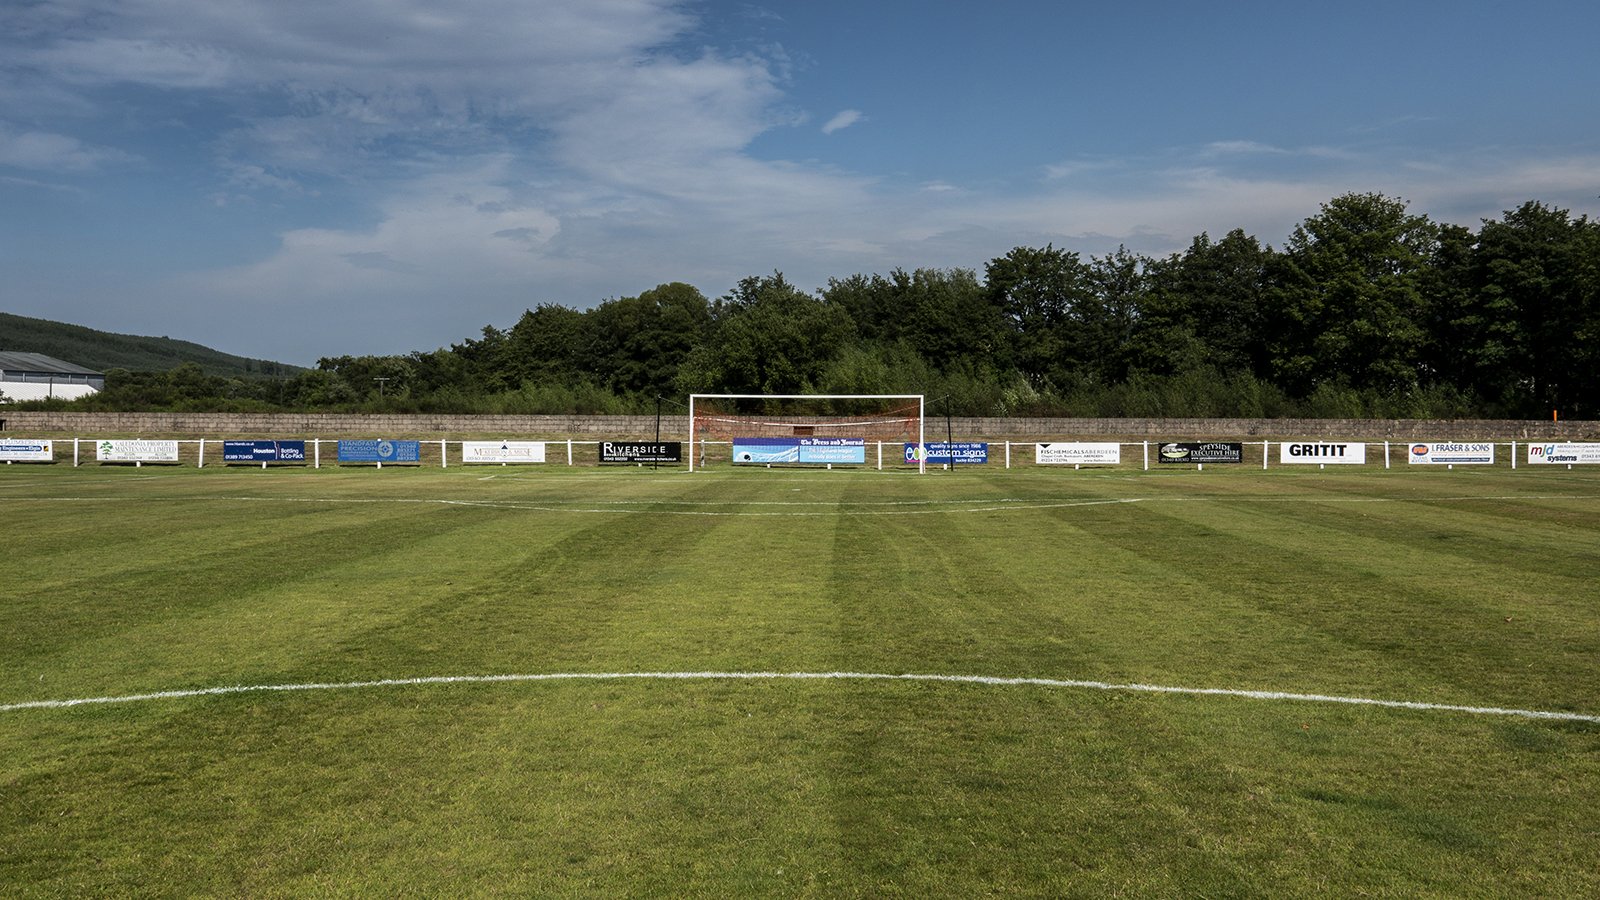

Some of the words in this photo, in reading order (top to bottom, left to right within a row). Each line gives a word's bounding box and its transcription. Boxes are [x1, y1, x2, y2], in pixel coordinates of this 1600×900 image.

[604, 442, 666, 456] RIVERSIDE
[963, 448, 986, 458] signs
[1289, 444, 1347, 456] GRITIT
[1531, 444, 1554, 457] mjd
